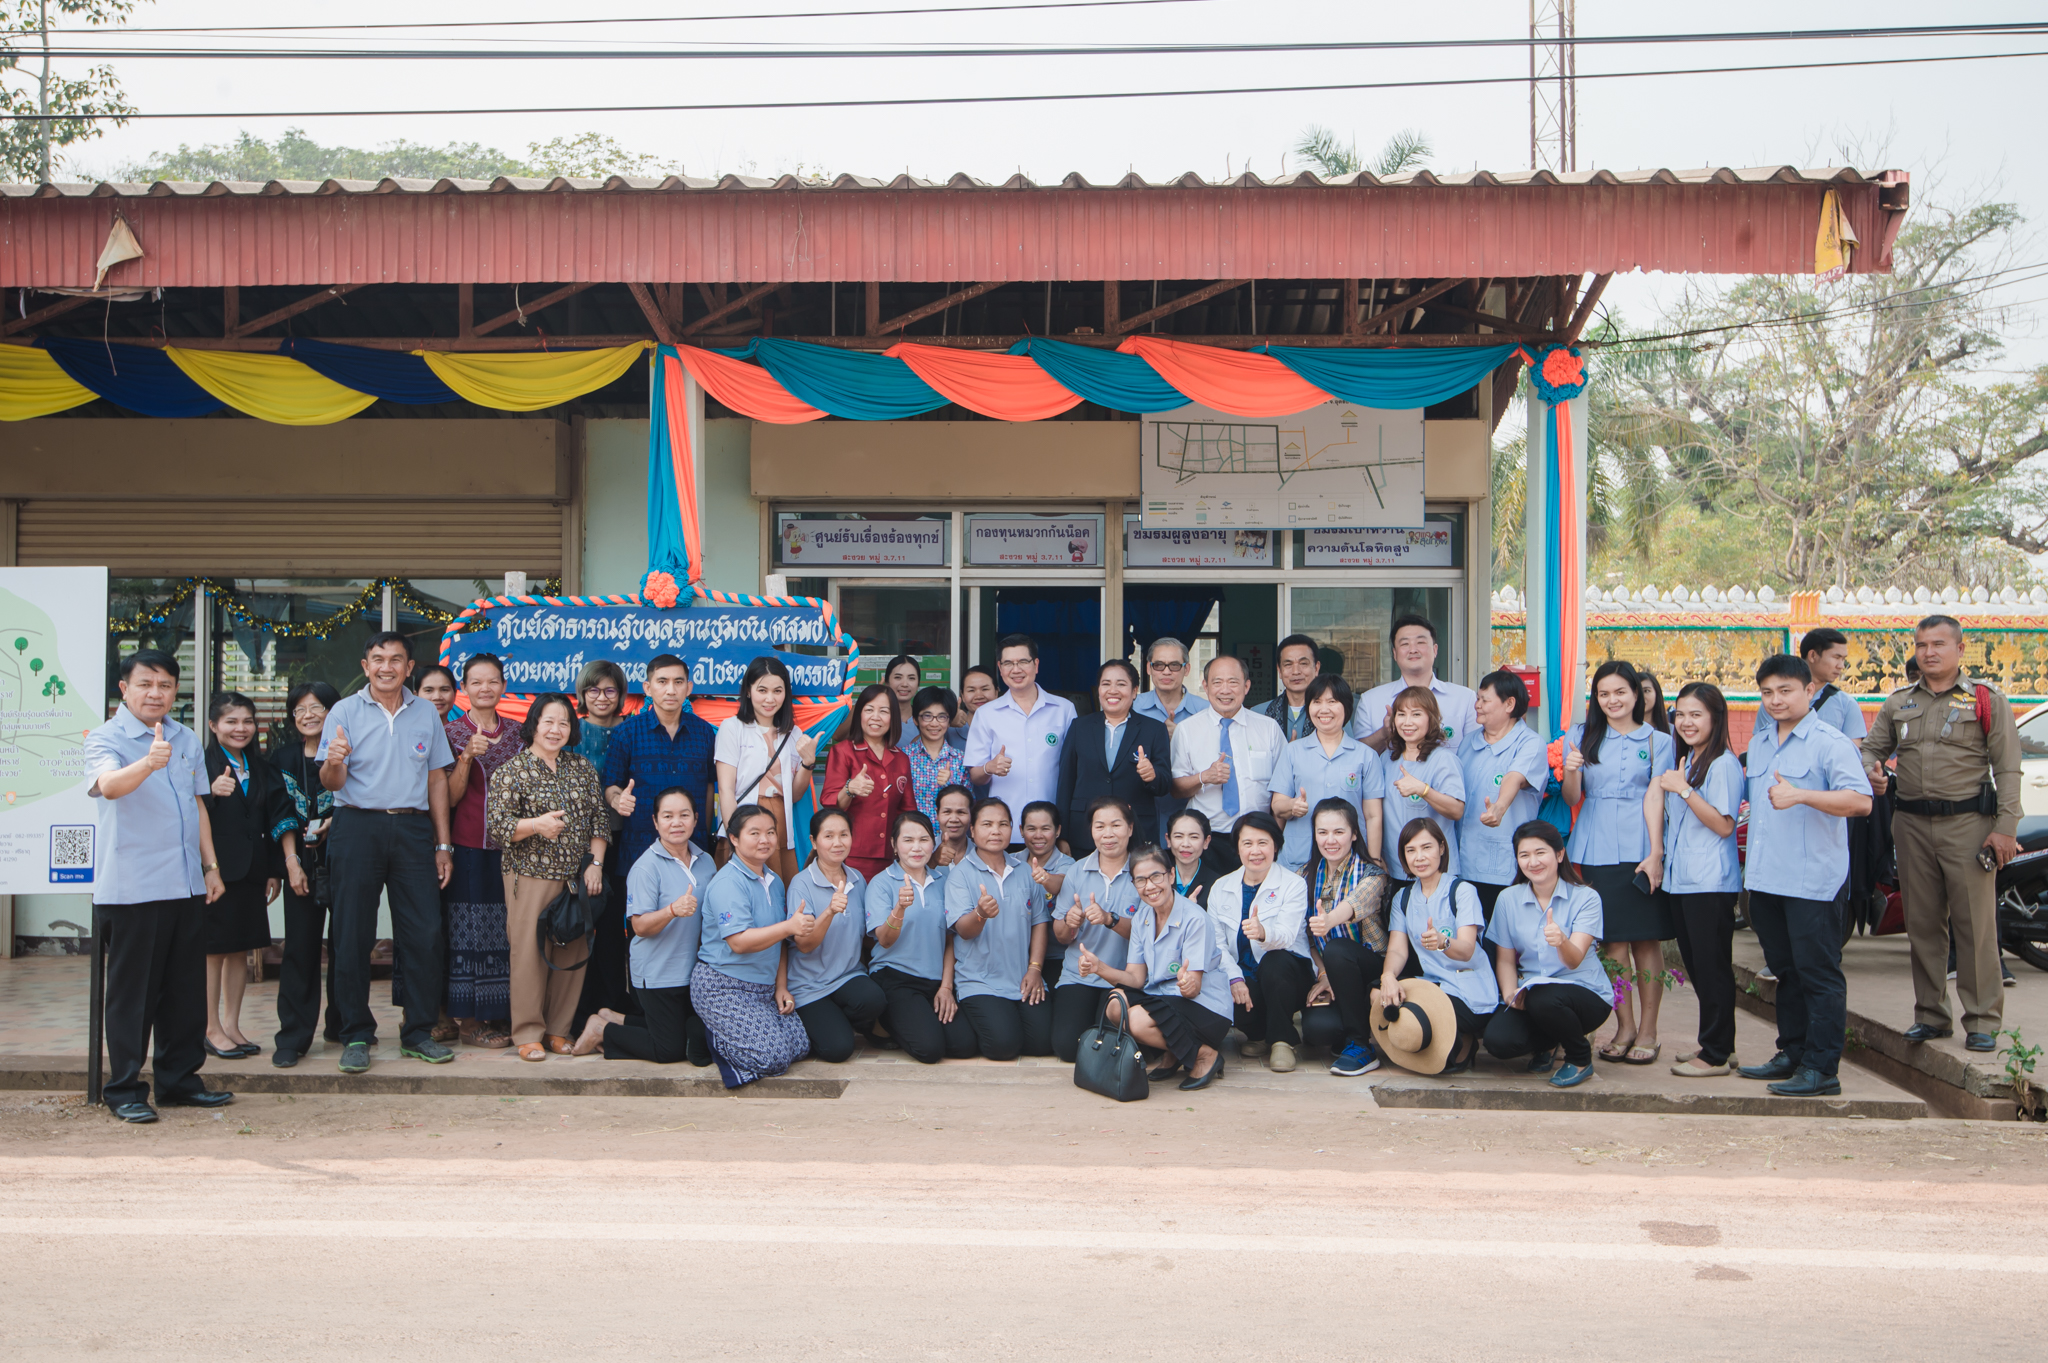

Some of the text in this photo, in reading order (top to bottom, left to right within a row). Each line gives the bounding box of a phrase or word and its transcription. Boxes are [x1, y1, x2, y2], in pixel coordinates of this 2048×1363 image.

[815, 525, 940, 549] ศูนย์รับเรื่องร้องทุกข์
[976, 523, 1090, 543] กองทุนหมวกกันน็อค
[1307, 541, 1410, 556] ความดันโลหิตสูง
[869, 552, 881, 563] หมู่
[1026, 552, 1038, 563] หมู่
[1189, 555, 1201, 566] หมู่
[1363, 556, 1373, 565] หมู่
[39, 759, 63, 767] OTOP
